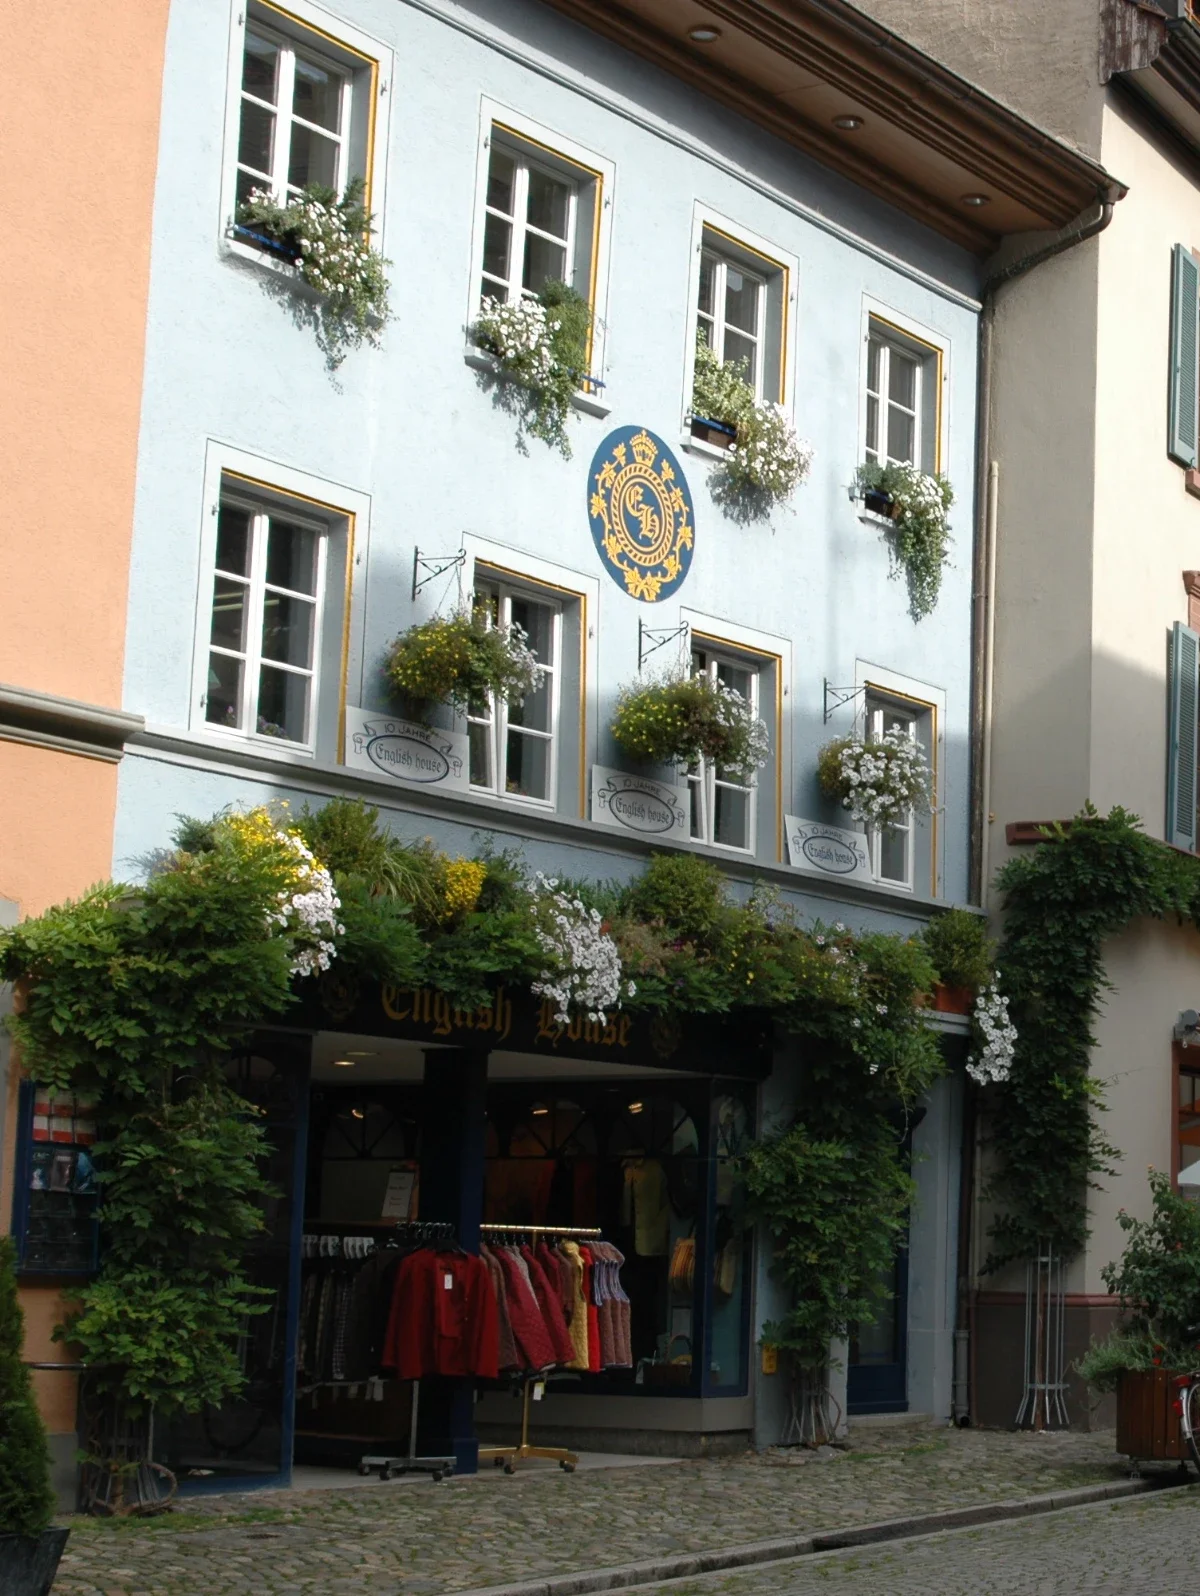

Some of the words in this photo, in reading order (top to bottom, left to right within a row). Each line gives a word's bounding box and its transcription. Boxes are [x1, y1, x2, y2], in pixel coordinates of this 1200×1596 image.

[384, 723, 396, 733] 10
[398, 725, 432, 744] JAHRE
[375, 743, 413, 770] English
[623, 778, 632, 788] 10
[633, 779, 661, 797] JAHRE
[615, 797, 646, 822] English
